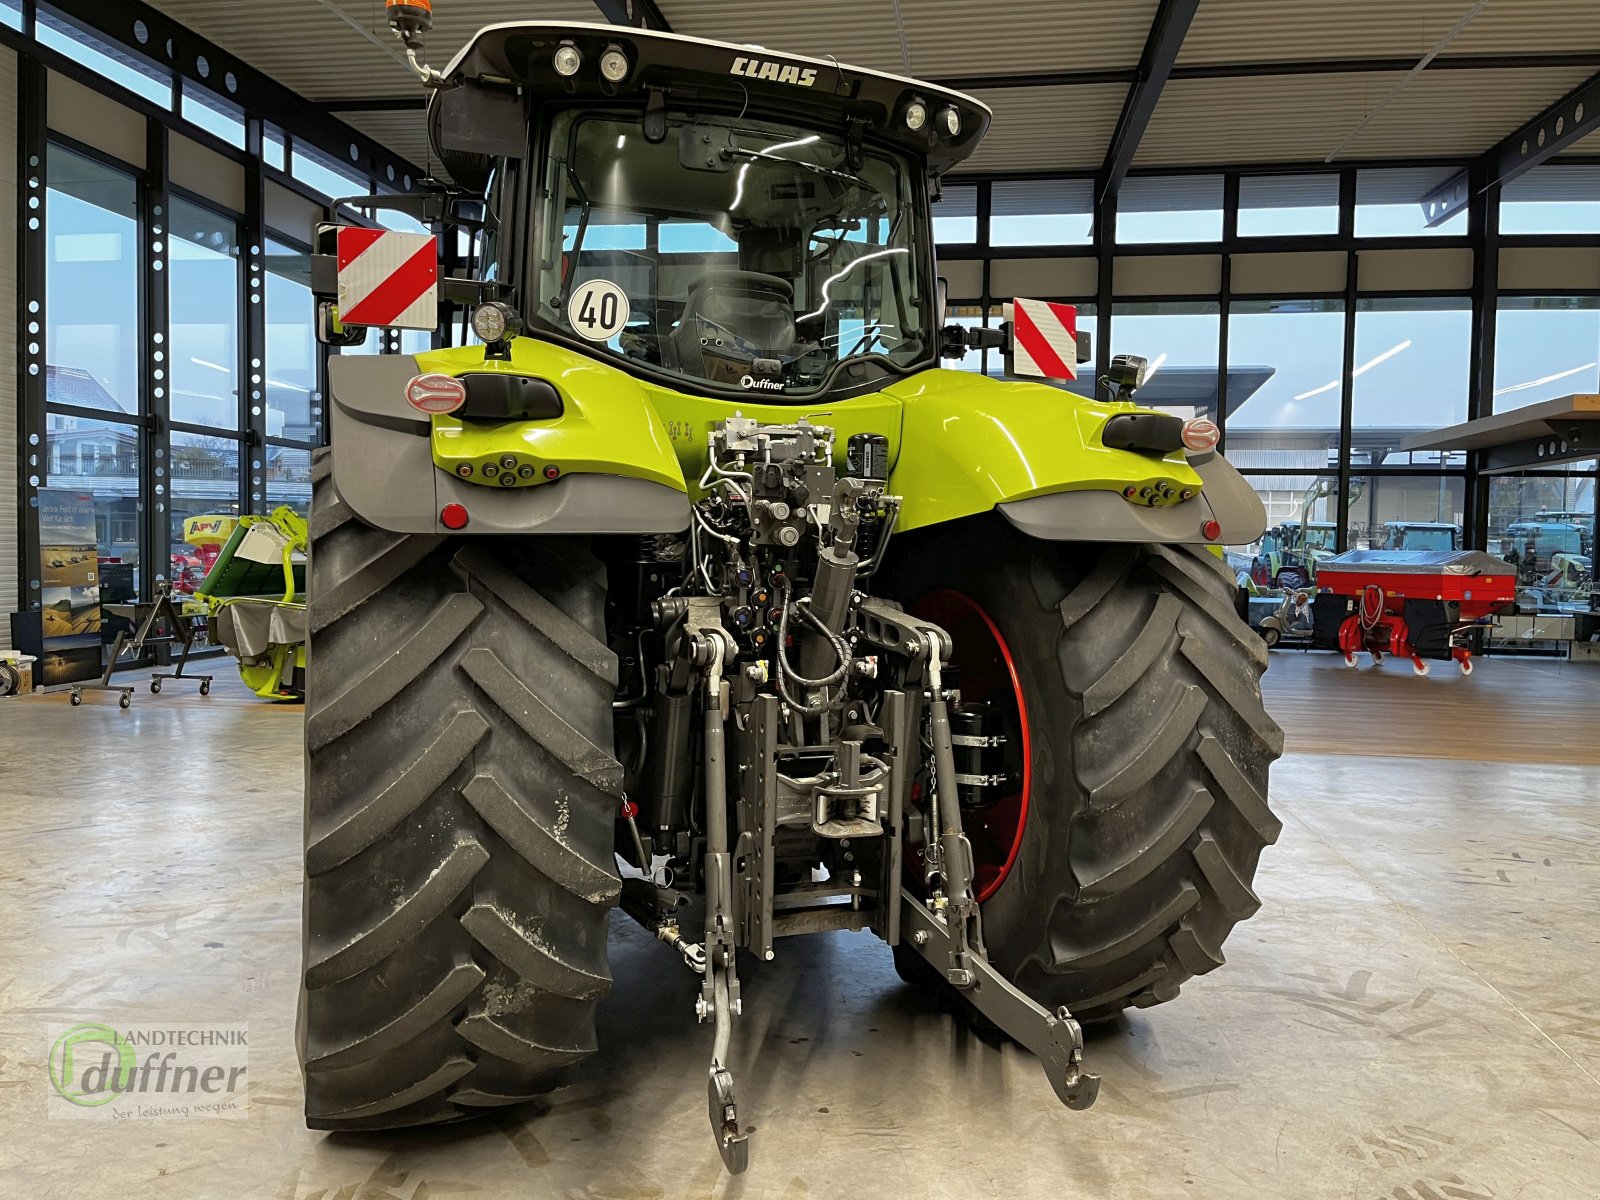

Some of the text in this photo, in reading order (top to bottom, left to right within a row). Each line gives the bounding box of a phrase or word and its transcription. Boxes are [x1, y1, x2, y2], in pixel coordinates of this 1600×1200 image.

[730, 57, 818, 87] CLAAS
[578, 291, 618, 330] 40
[740, 374, 785, 390] Duffner
